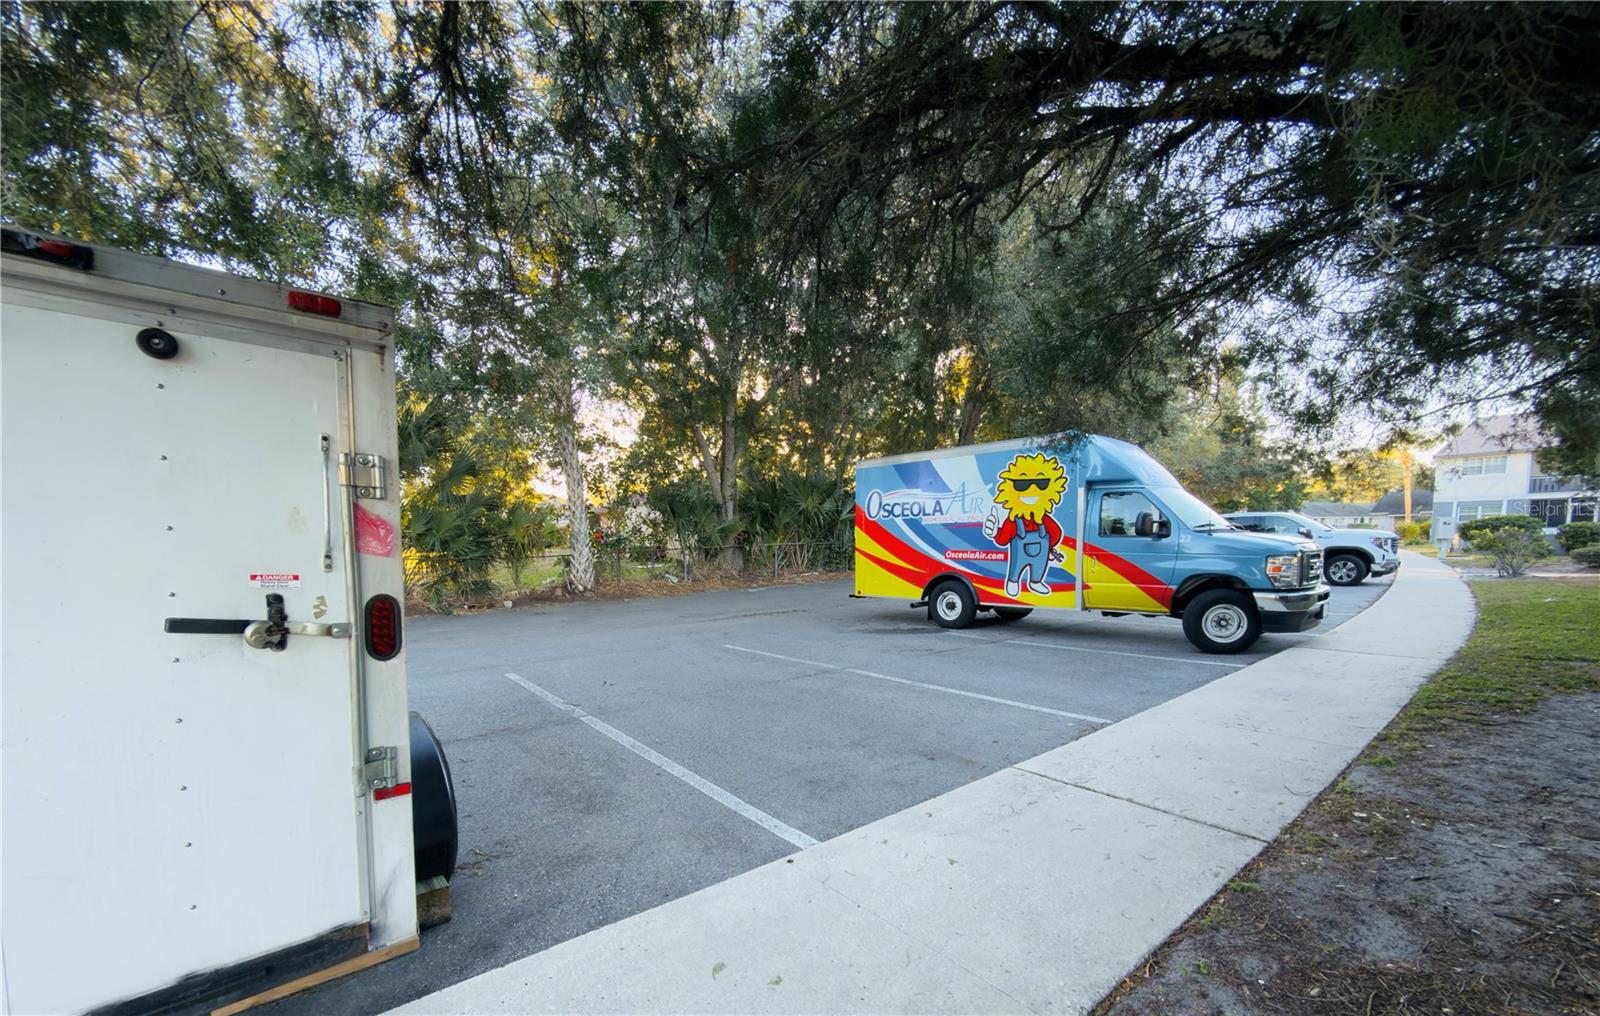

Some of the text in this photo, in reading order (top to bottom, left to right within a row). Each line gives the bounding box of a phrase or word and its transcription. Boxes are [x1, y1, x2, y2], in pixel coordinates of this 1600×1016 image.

[867, 481, 984, 519] OSCEOLA AIR
[945, 550, 1005, 560] OsceolaAir.com
